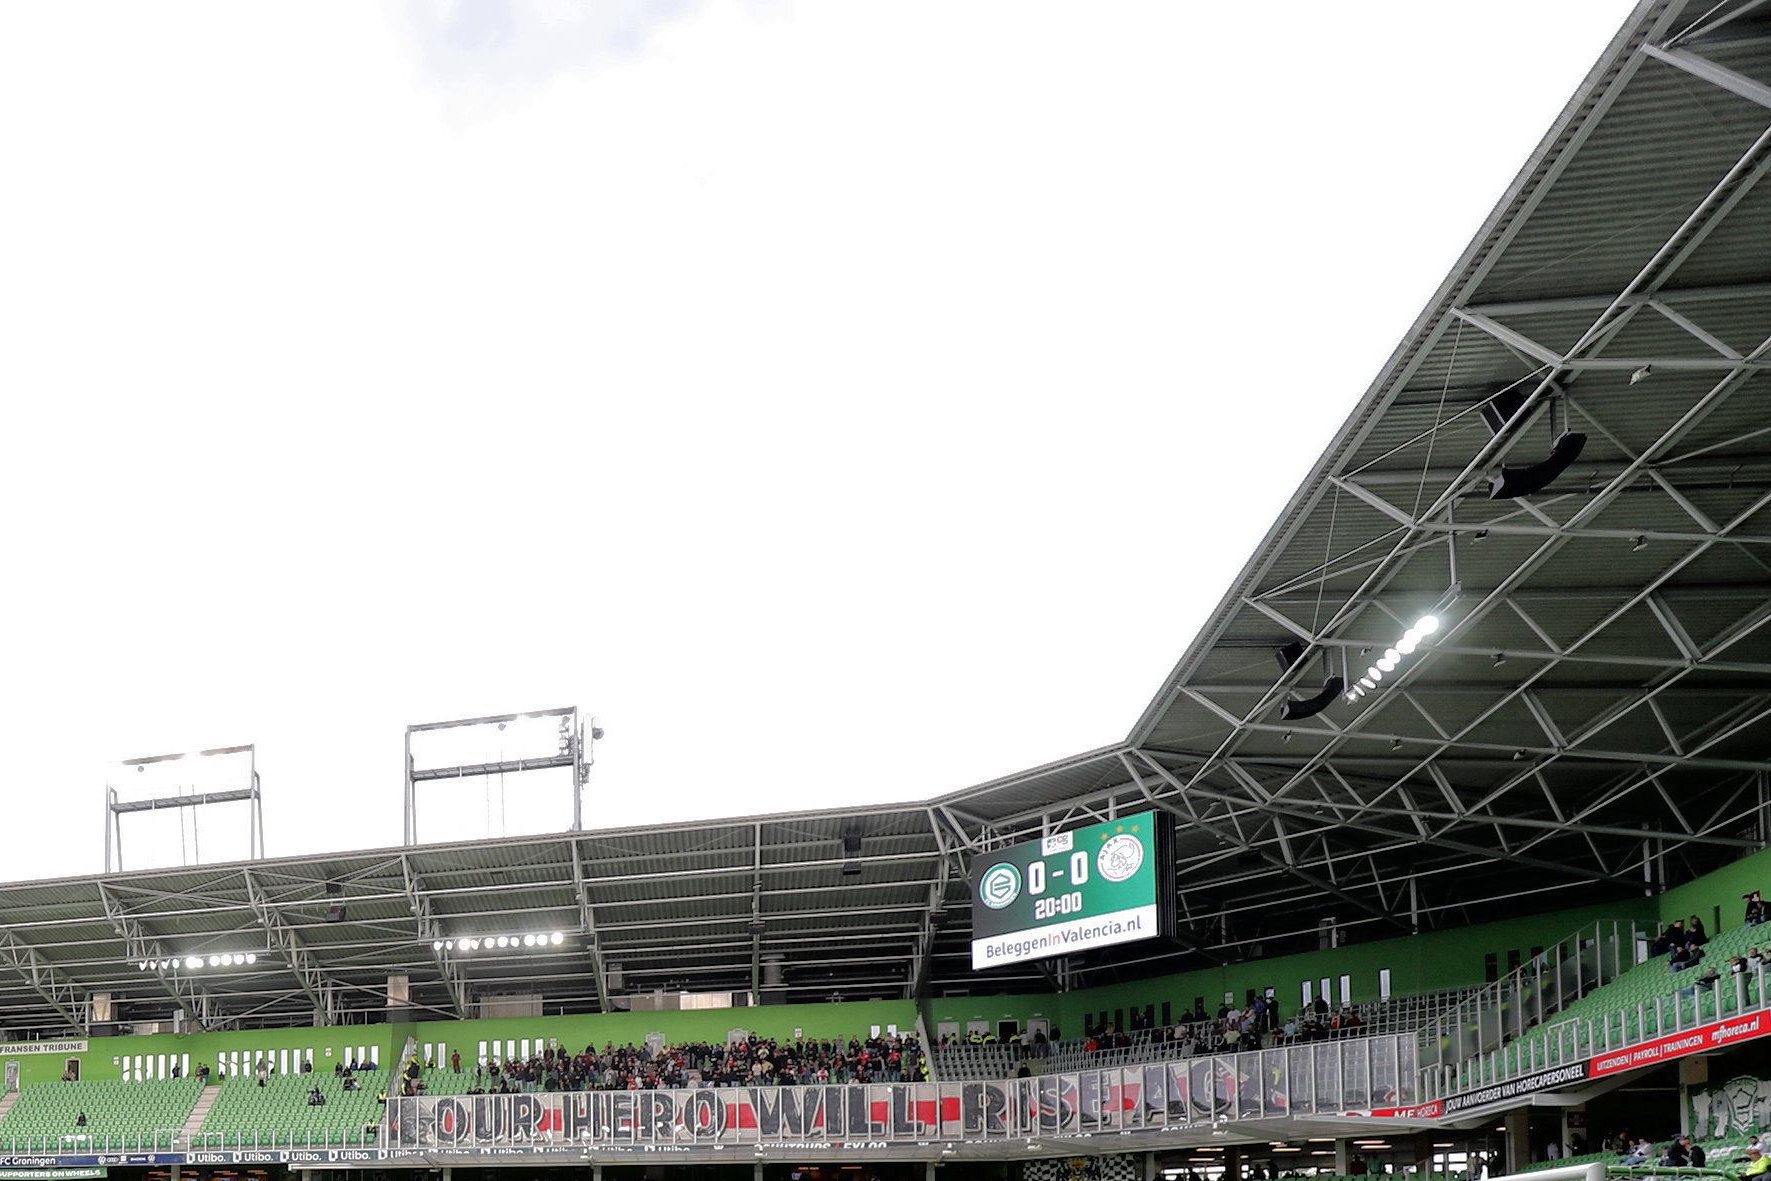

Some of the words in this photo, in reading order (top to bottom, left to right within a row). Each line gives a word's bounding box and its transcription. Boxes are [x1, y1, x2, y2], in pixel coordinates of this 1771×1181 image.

[1034, 891, 1082, 920] 20:00
[986, 915, 1141, 959] BeleggenInValencia.nl
[0, 1044, 40, 1054] FRANSEN
[43, 1042, 83, 1051] TRIBUNE
[1633, 1047, 1660, 1061] PAYROLL
[1664, 1034, 1703, 1053] TRAININGEN
[1502, 1083, 1516, 1097] VAN
[430, 1095, 546, 1146] OUR
[563, 1090, 726, 1146] HERO
[749, 1086, 933, 1139] WILL
[197, 1154, 227, 1162] Utibo.
[244, 1153, 274, 1161] Utibo.
[291, 1153, 322, 1161] Utibo.
[340, 1152, 371, 1160] Utibo.
[12, 1157, 56, 1167] Groningen
[65, 1169, 101, 1177] WHEELS
